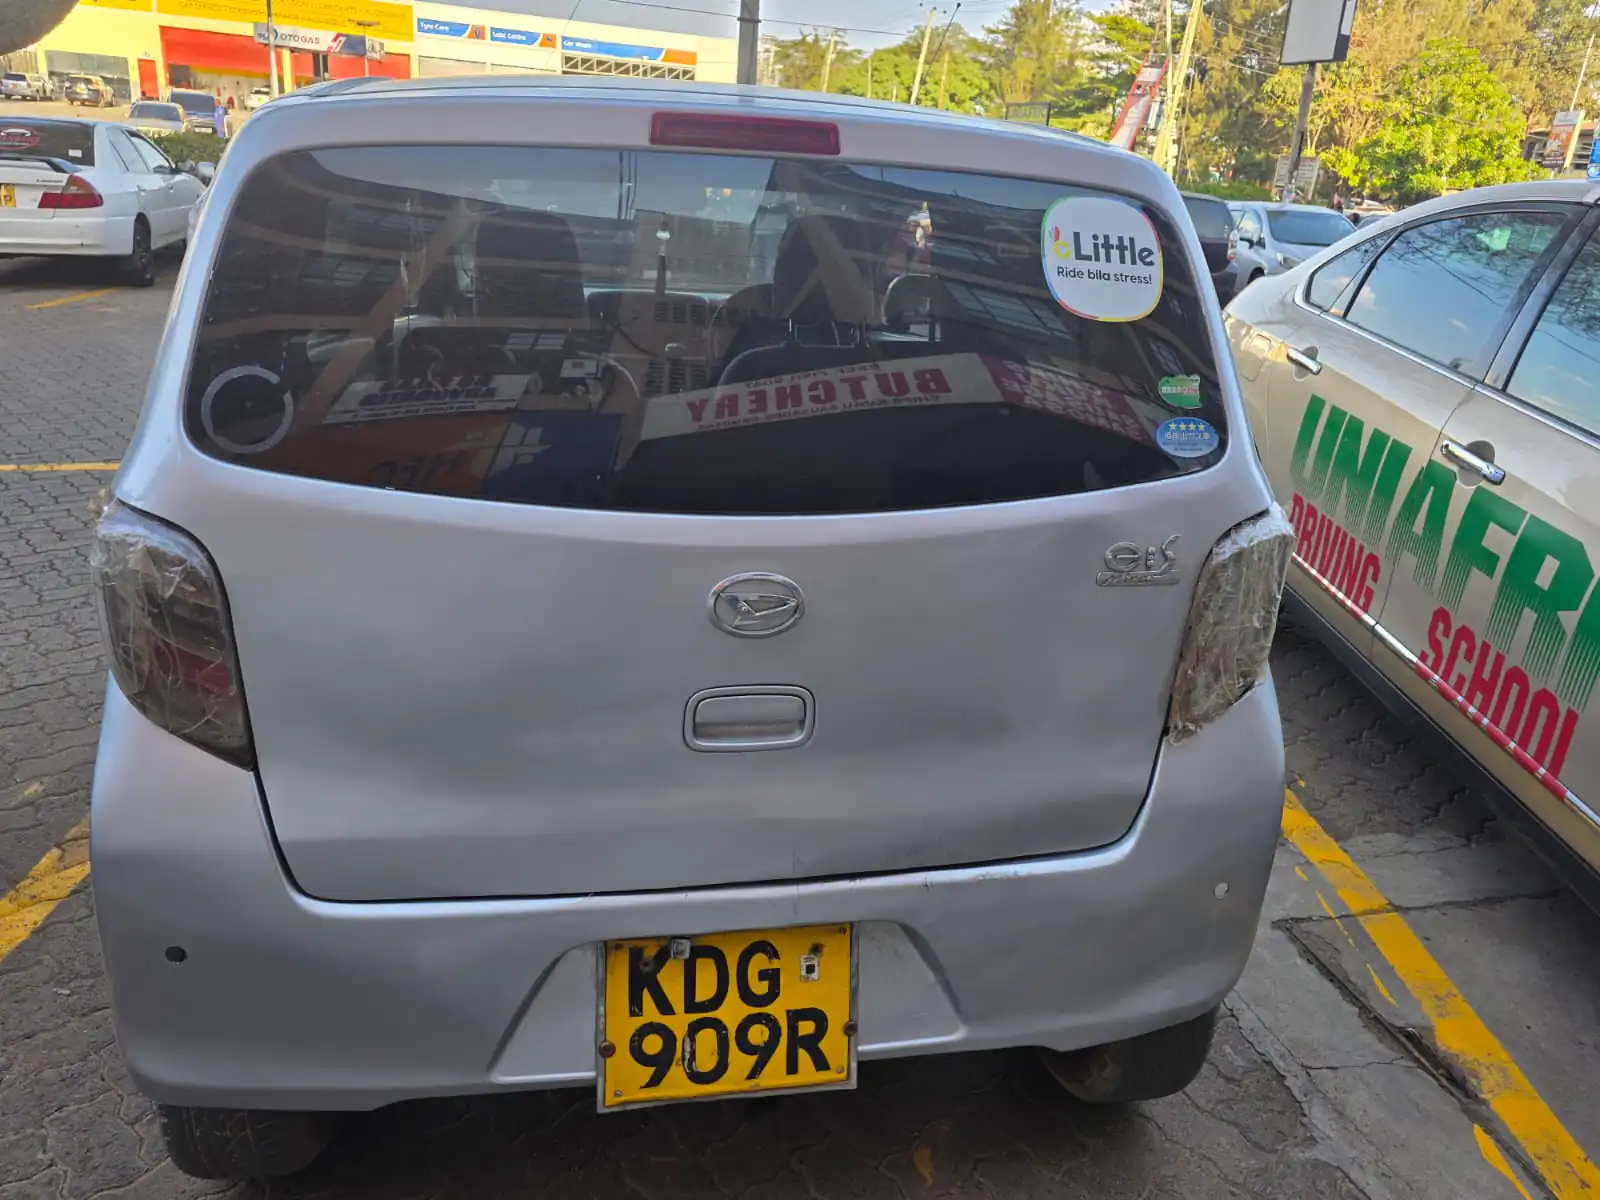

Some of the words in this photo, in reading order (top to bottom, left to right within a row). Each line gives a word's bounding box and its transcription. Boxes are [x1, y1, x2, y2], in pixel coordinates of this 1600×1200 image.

[1057, 266, 1084, 279] Ride
[1087, 268, 1111, 281] bila
[1113, 272, 1153, 285] stress!
[1073, 231, 1155, 267] Little
[627, 940, 781, 1018] KDG
[628, 1006, 831, 1089] 909R
